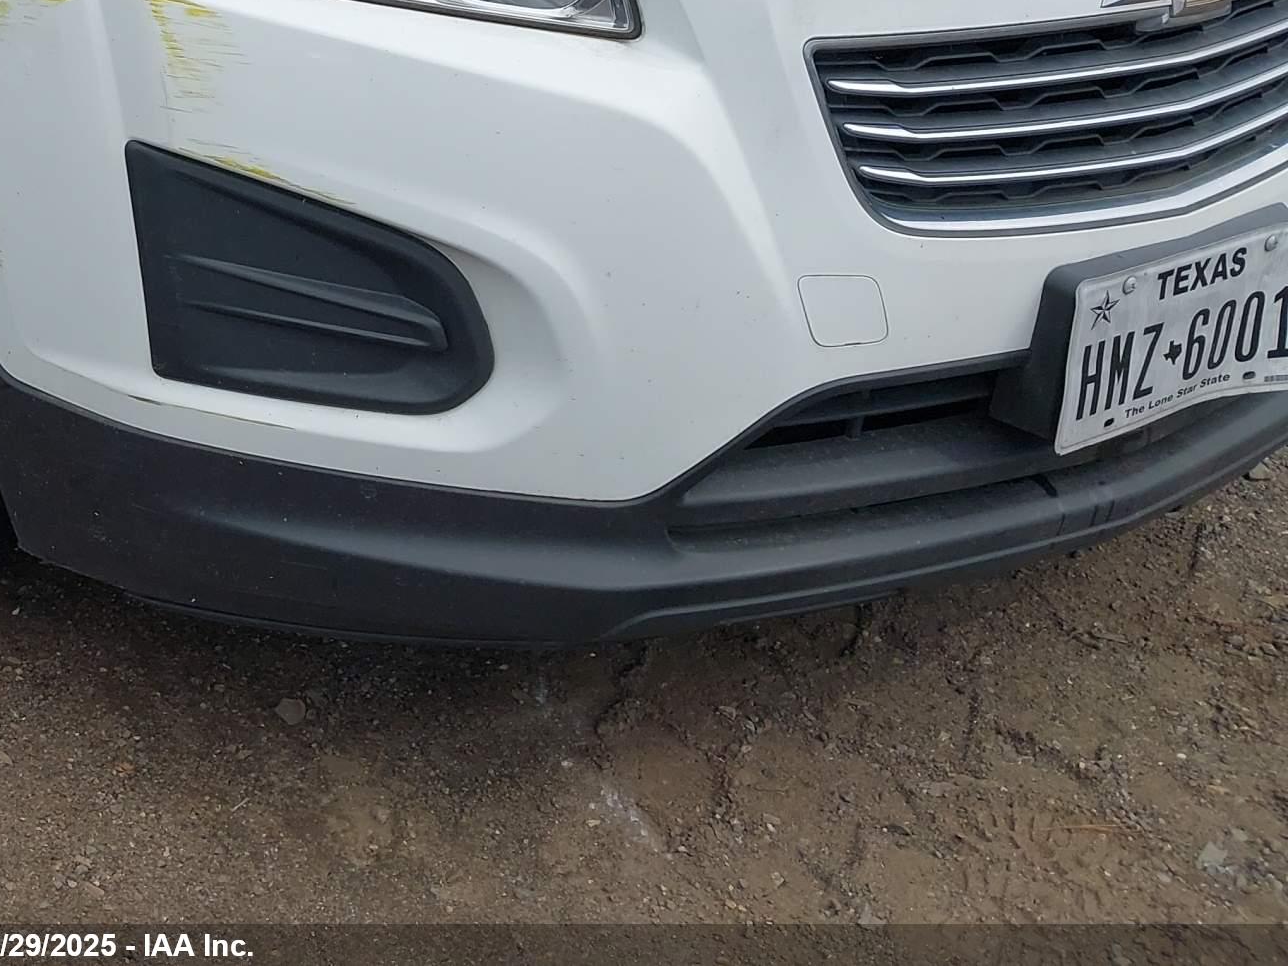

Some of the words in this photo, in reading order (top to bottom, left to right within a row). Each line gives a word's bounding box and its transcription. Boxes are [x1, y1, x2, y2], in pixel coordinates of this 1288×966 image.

[1157, 246, 1248, 301] TEXAS
[1124, 405, 1145, 419] The
[1148, 394, 1174, 410] Lone
[1176, 384, 1197, 399] Star
[1199, 373, 1231, 388] State
